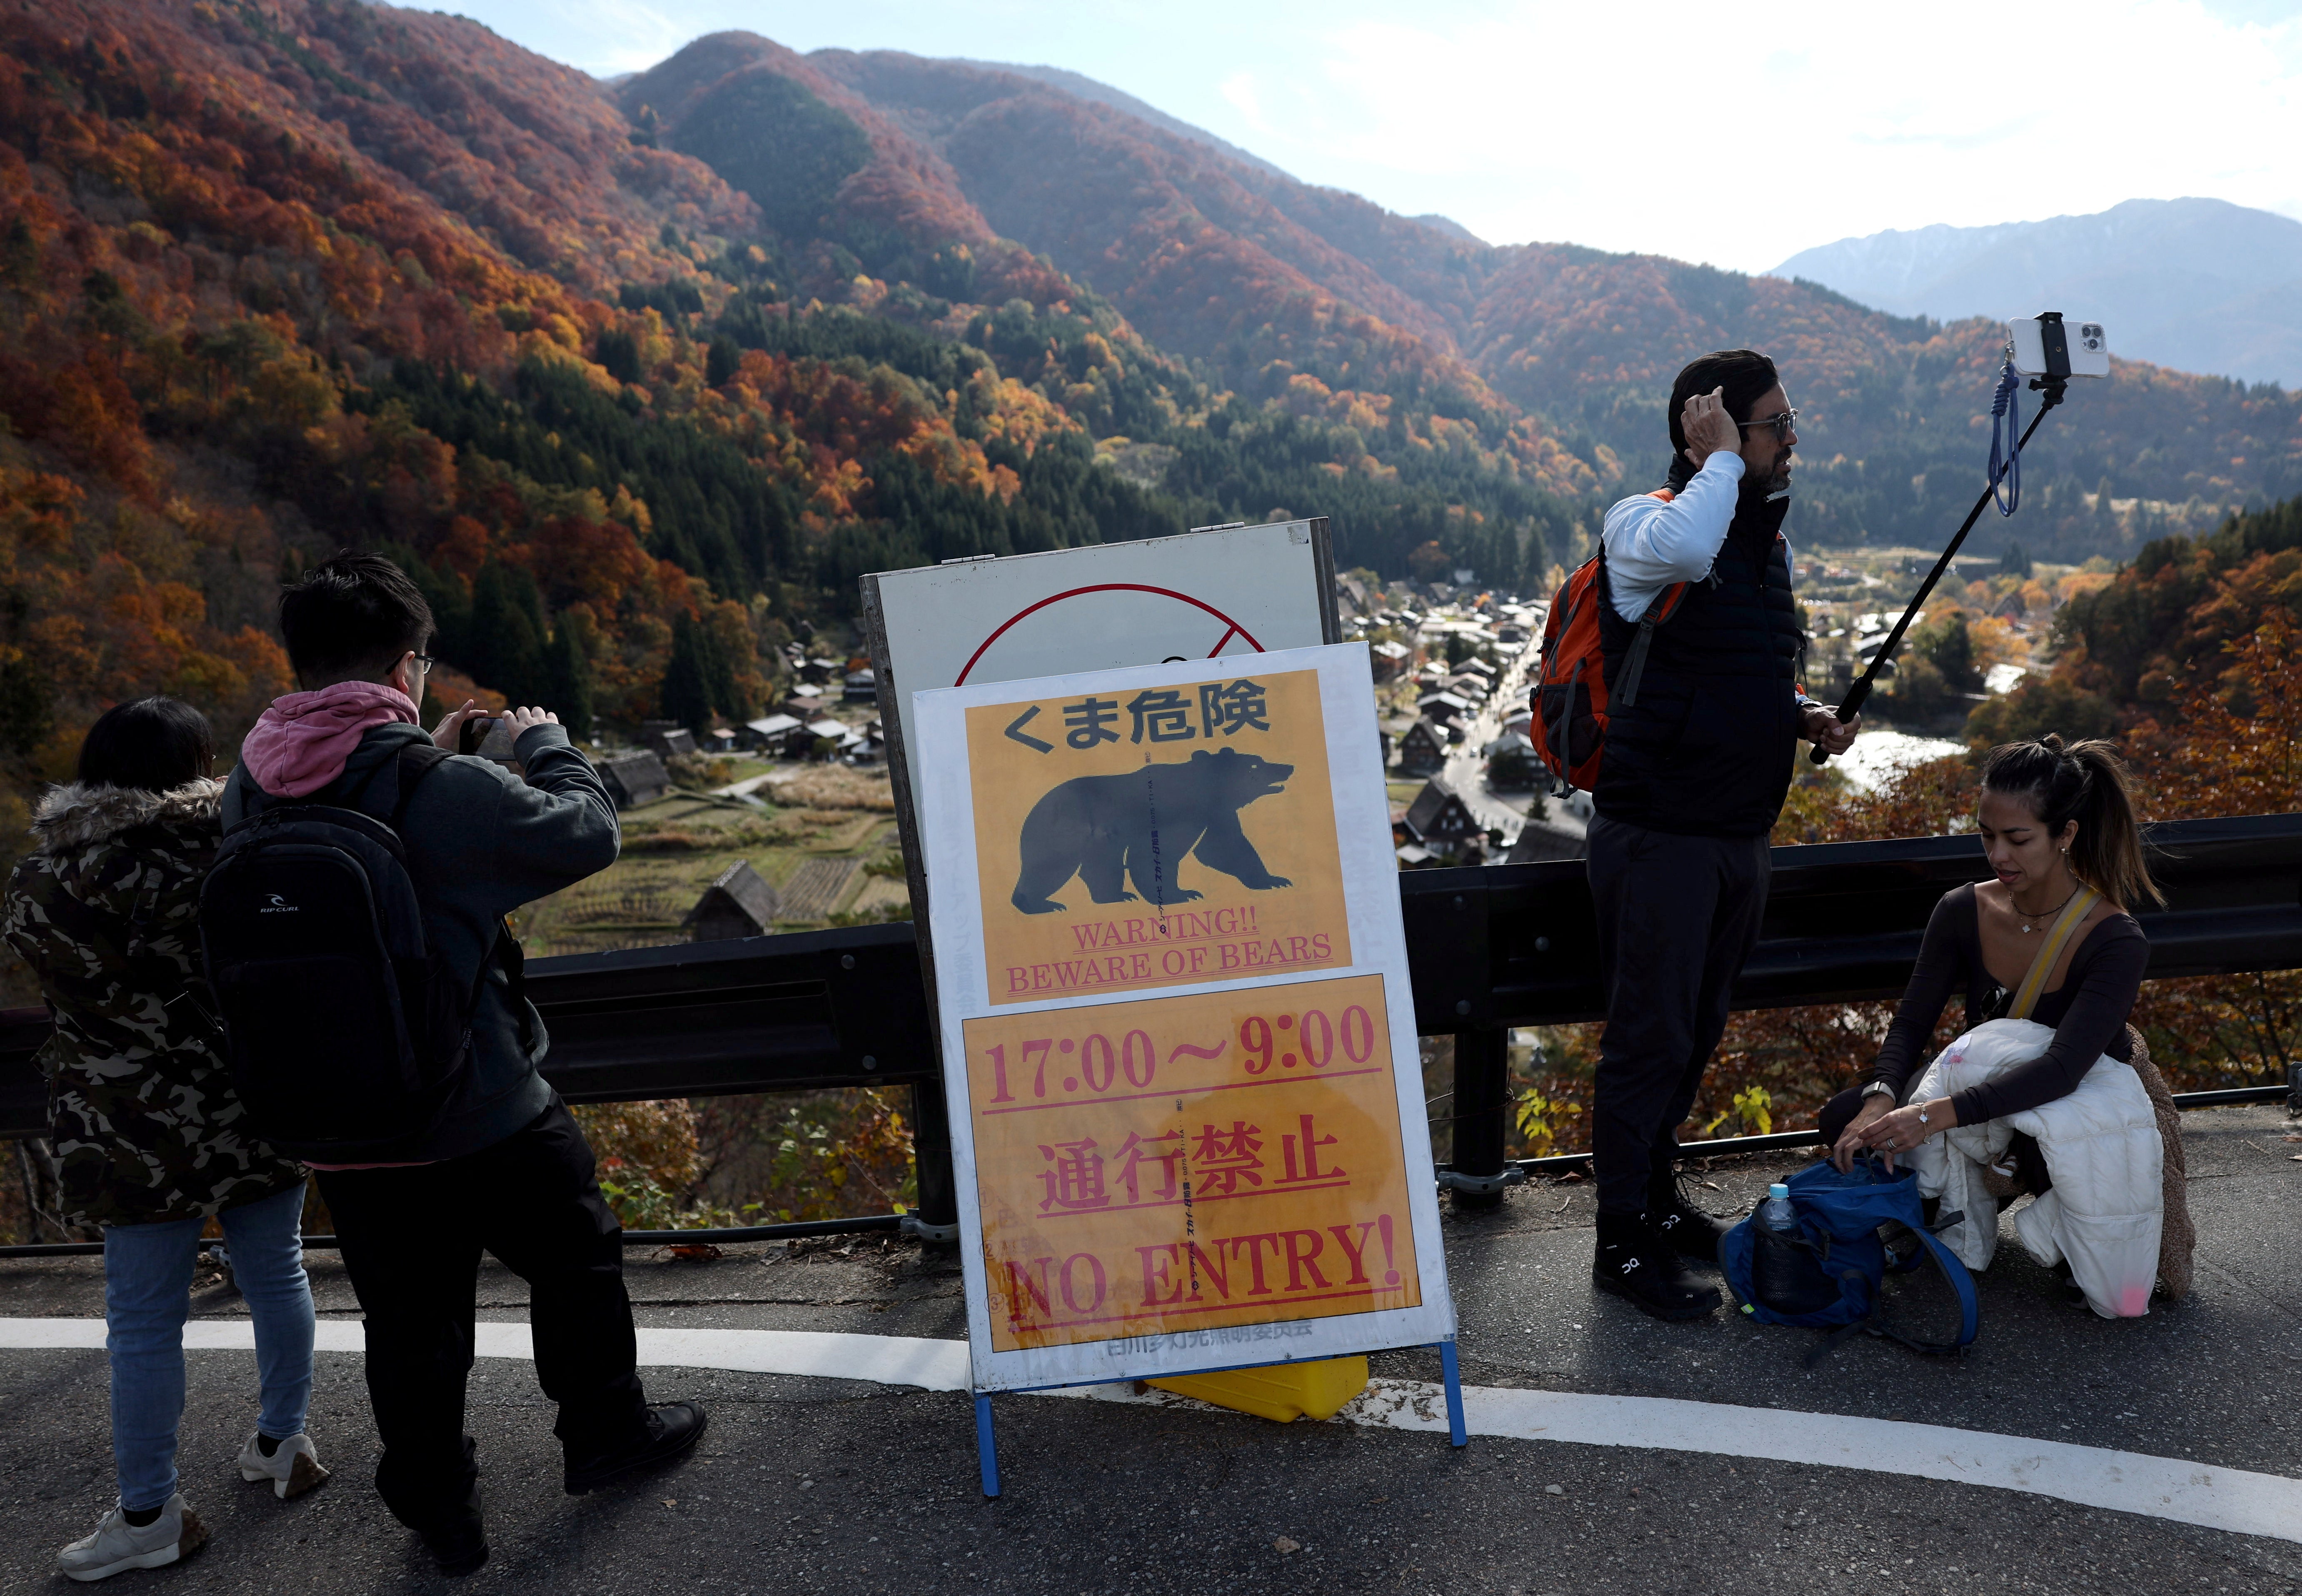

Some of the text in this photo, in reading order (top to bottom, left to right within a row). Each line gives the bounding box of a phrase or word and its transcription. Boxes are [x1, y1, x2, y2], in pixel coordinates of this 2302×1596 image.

[1004, 679, 1271, 754] くま危険
[1006, 934, 1332, 992] BEWARE OF BEARS
[1071, 906, 1257, 948] WARNING!!
[1036, 1114, 1347, 1211] 通行禁止
[1003, 1214, 1401, 1322] NO ENTRY!
